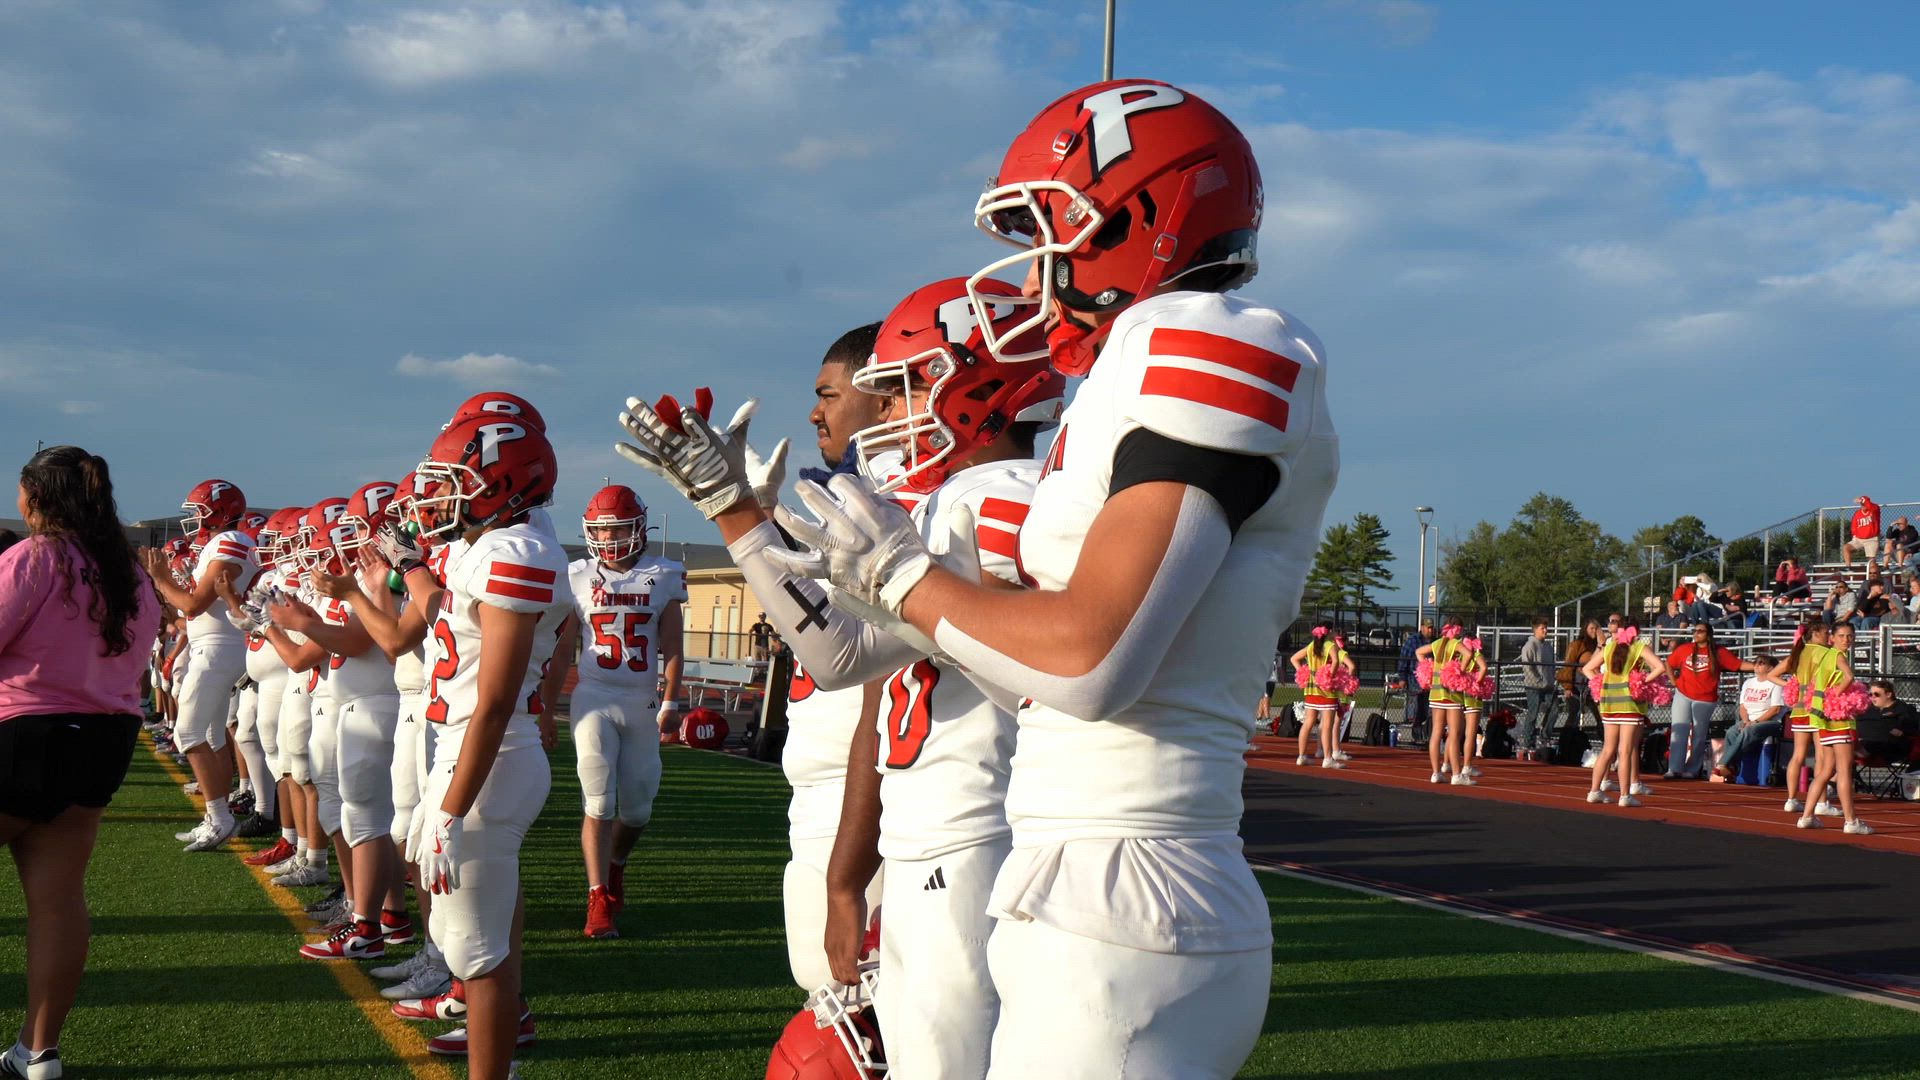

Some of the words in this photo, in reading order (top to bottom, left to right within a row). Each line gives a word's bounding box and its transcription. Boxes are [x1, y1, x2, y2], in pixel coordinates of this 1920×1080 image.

[1079, 84, 1185, 178] P
[479, 422, 526, 468] P
[211, 482, 231, 502] P
[364, 485, 396, 517] P
[590, 613, 653, 672] 55
[696, 724, 715, 740] QB
